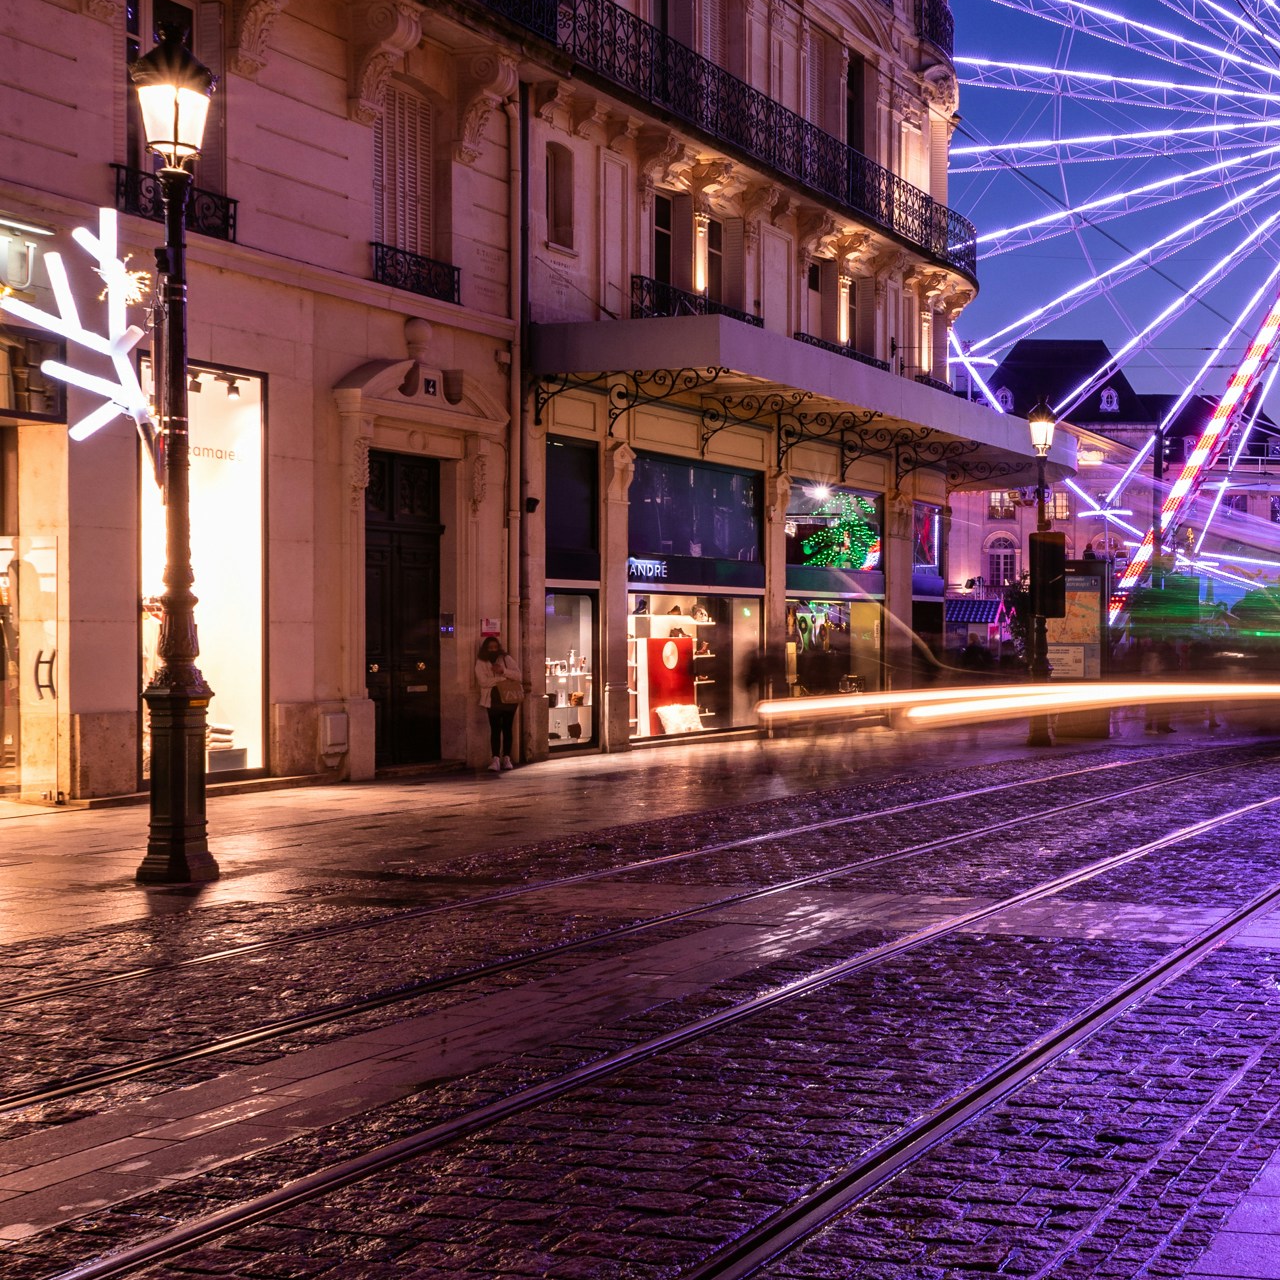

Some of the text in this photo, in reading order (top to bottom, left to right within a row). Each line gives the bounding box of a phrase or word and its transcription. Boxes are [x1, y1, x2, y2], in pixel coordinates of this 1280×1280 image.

[428, 381, 434, 394] 4
[188, 446, 243, 462] amaie
[629, 561, 668, 577] ANDRÉ
